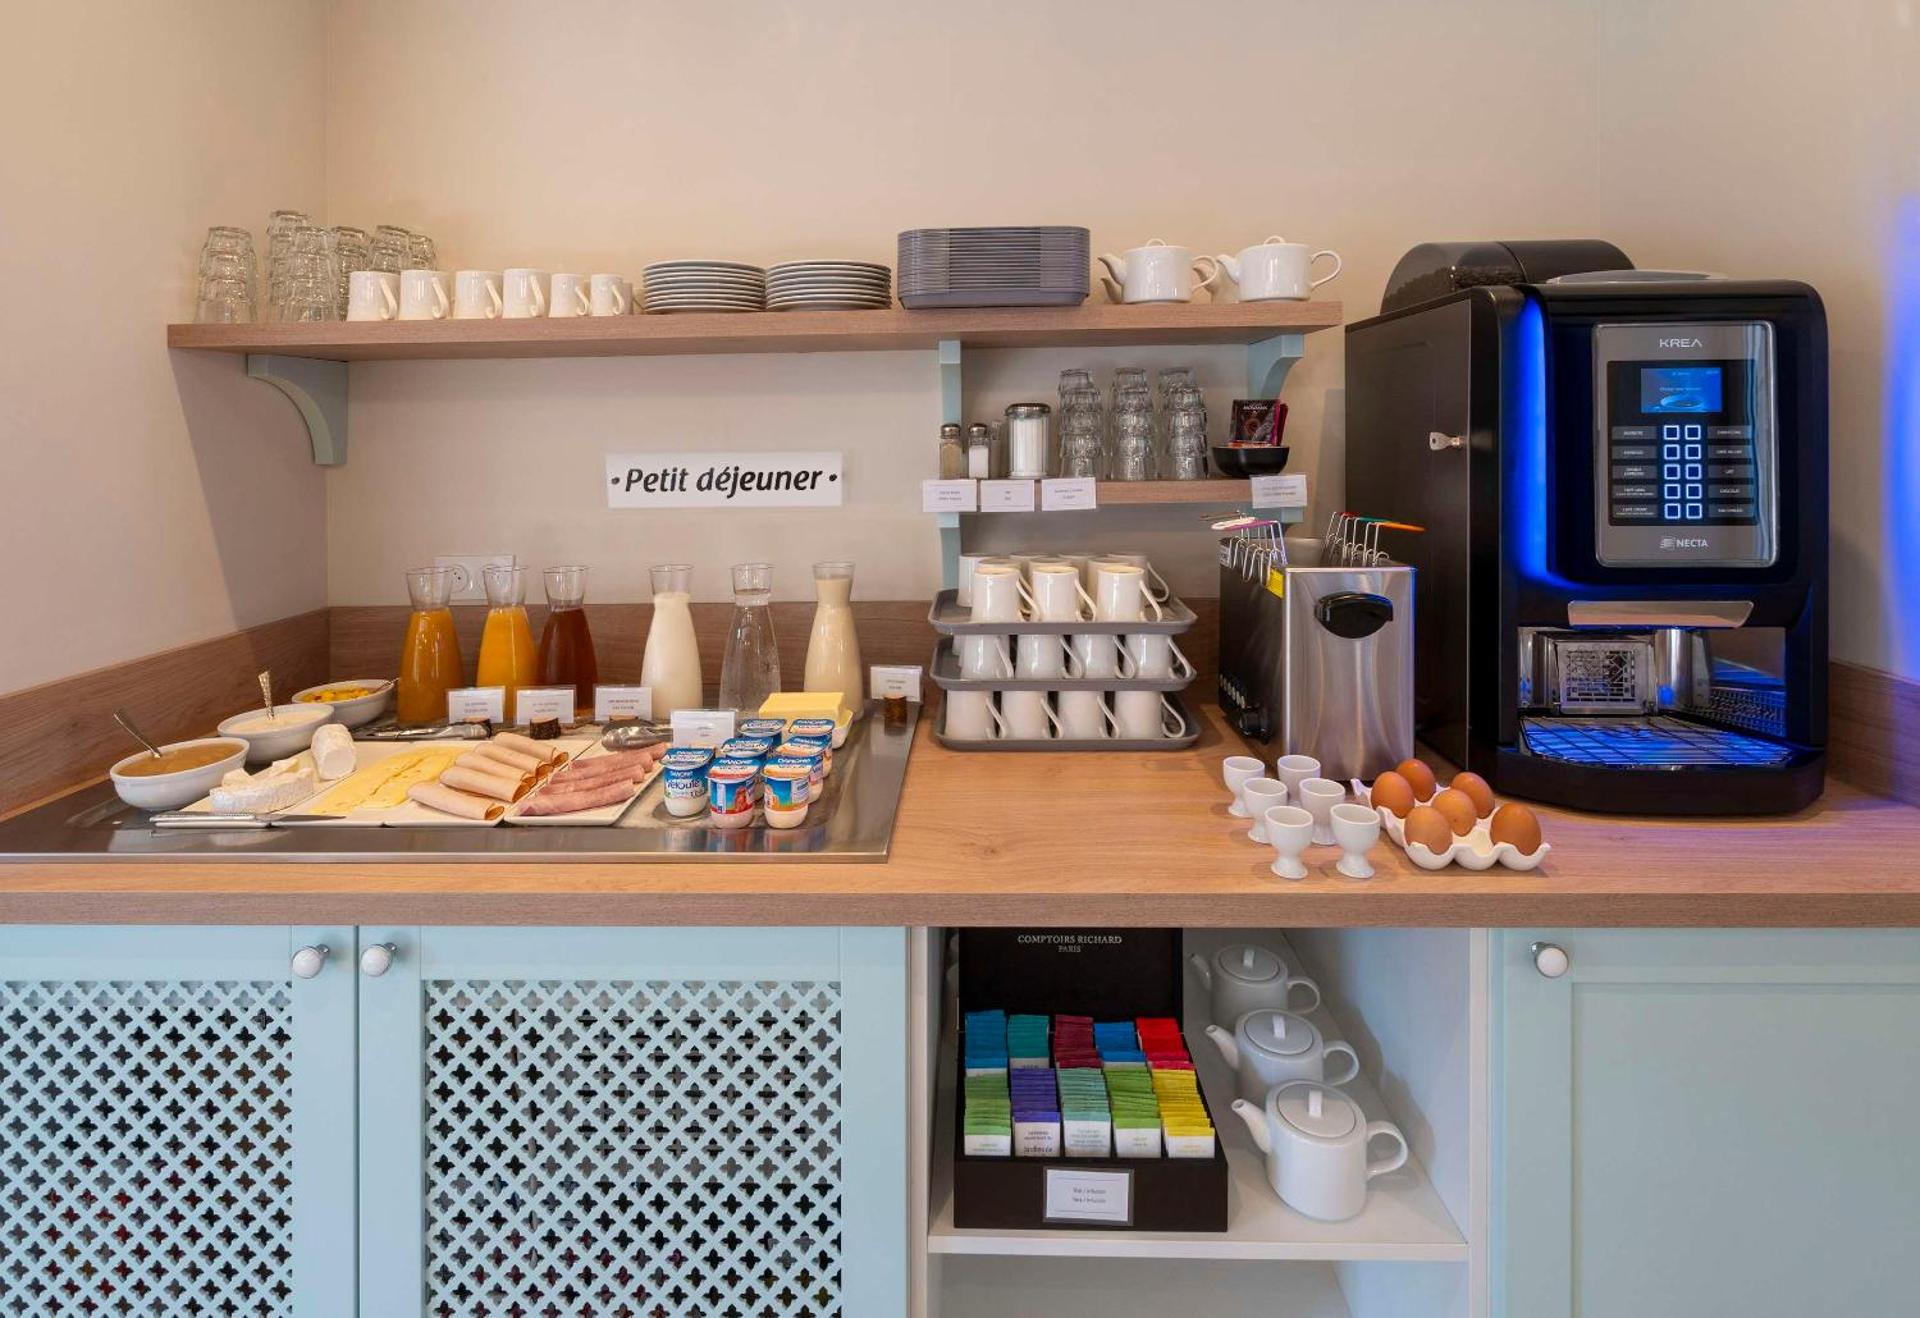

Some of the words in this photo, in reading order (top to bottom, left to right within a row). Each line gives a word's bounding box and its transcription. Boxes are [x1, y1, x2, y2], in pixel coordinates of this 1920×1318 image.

[1659, 338, 1703, 348] KREA
[625, 467, 689, 493] Petit
[696, 465, 824, 499] déjeuner
[1675, 539, 1709, 548] NECTA
[1017, 934, 1075, 944] COMPTOIRS
[1077, 934, 1122, 944] RICHARD
[1057, 945, 1082, 953] PARIS
